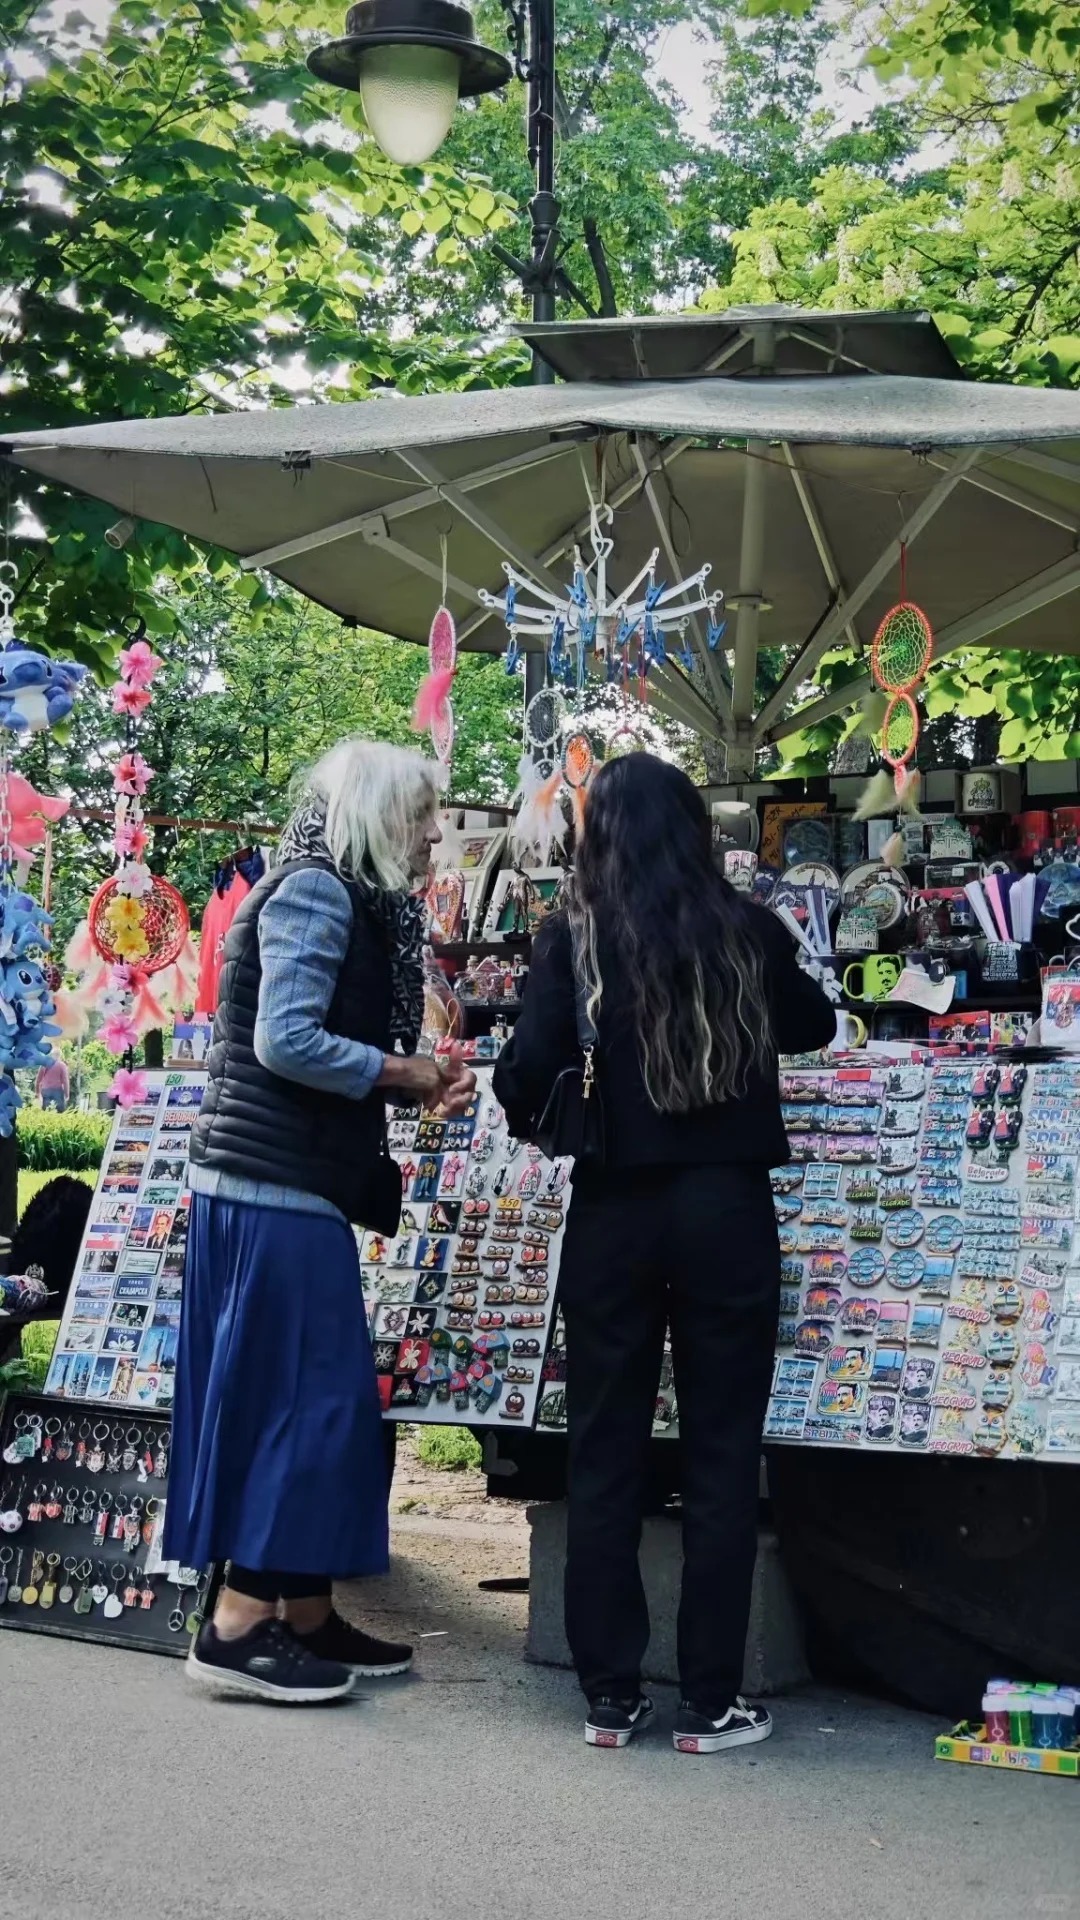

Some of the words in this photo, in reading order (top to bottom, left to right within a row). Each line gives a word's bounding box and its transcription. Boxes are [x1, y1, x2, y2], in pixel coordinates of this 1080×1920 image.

[499, 1197, 520, 1208] 350
[946, 1305, 990, 1322] BEOGRAD
[941, 1351, 985, 1367] BEOGRAD
[804, 1428, 841, 1440] SRBIJA
